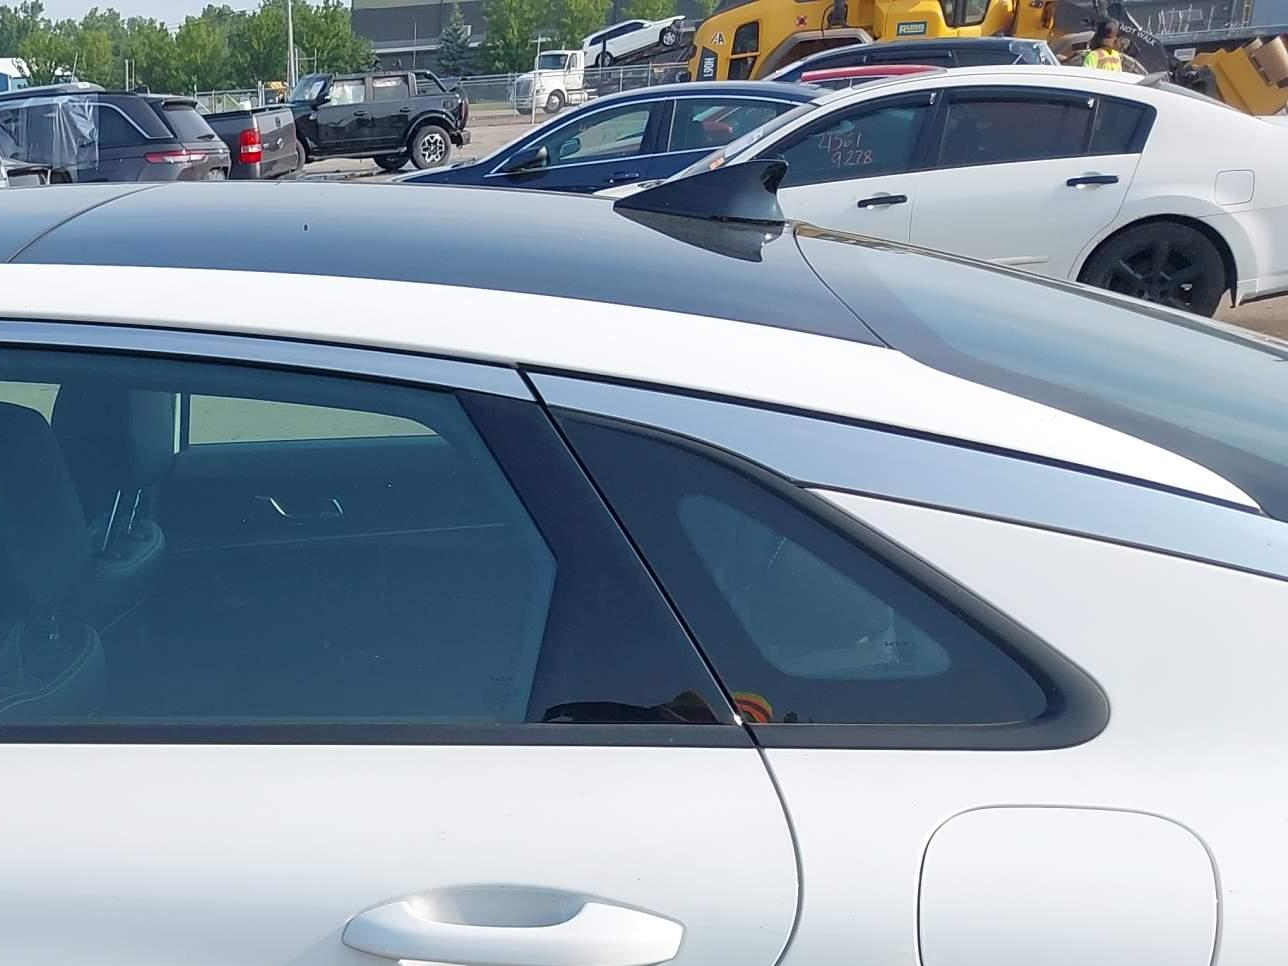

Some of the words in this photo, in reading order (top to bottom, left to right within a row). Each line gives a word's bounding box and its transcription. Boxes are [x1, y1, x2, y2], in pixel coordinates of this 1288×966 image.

[1120, 23, 1136, 34] NOT
[1137, 30, 1156, 46] WALK
[703, 57, 715, 77] L90H
[832, 149, 873, 168] 9278
